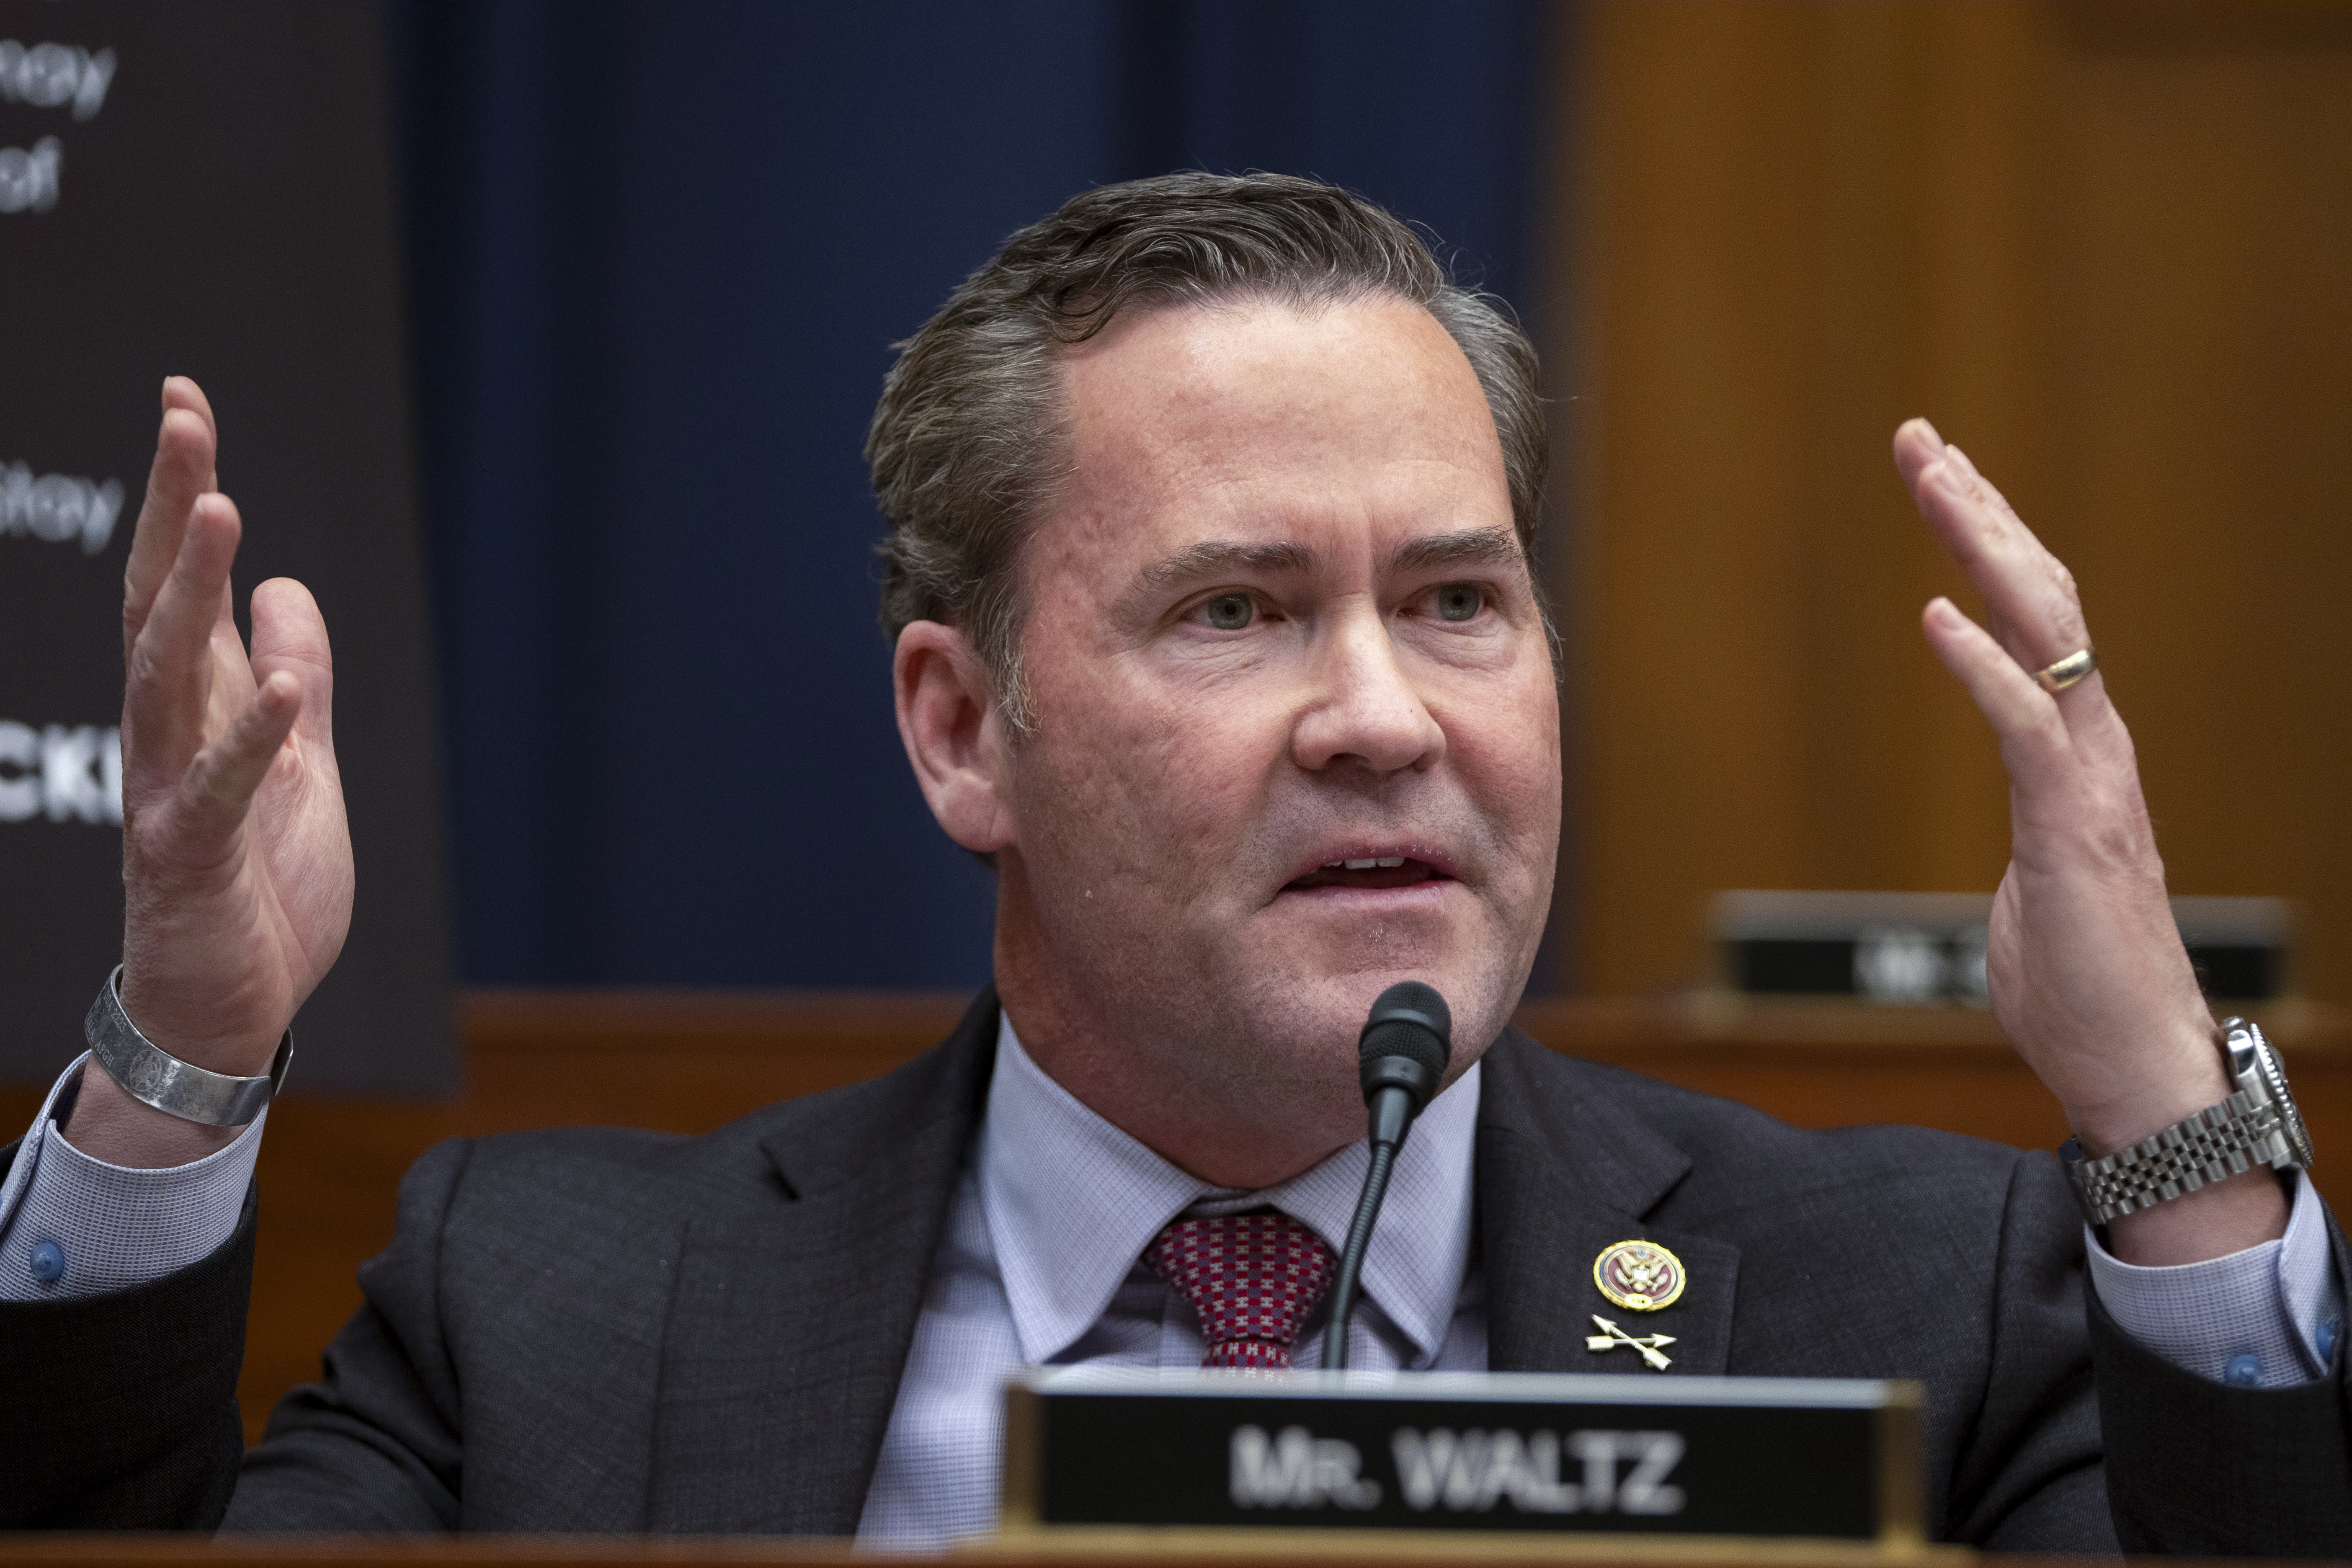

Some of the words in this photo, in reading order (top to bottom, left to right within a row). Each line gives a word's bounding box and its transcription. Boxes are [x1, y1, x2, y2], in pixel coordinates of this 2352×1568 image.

[0, 459, 126, 556] tay
[111, 1008, 126, 1033] 2223
[95, 1039, 115, 1068] AFGH
[1390, 1426, 1687, 1515] WALTZ
